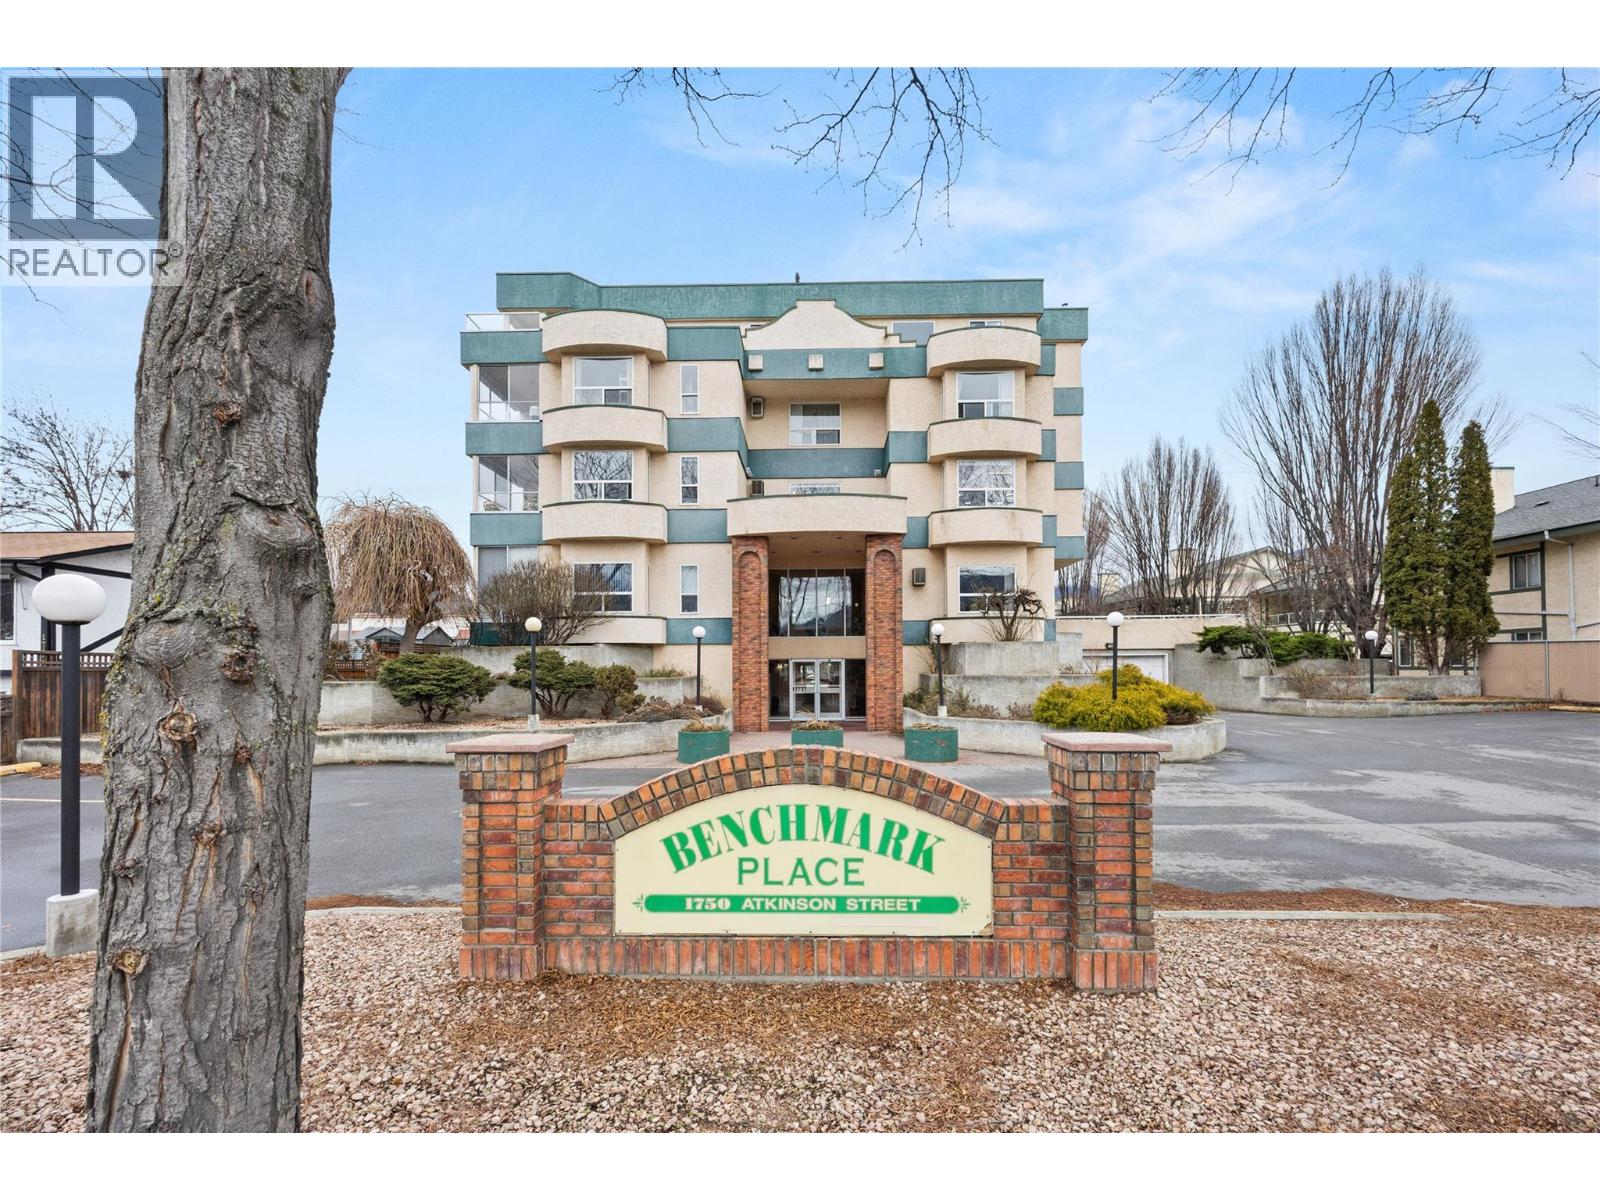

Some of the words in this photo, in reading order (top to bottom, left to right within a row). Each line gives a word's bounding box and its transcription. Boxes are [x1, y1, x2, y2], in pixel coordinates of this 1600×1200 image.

[660, 804, 946, 874] BENCHMARK
[737, 857, 865, 886] PLACE
[685, 897, 731, 910] 1750
[741, 898, 836, 911] ATKINSON
[846, 898, 921, 911] STREET
